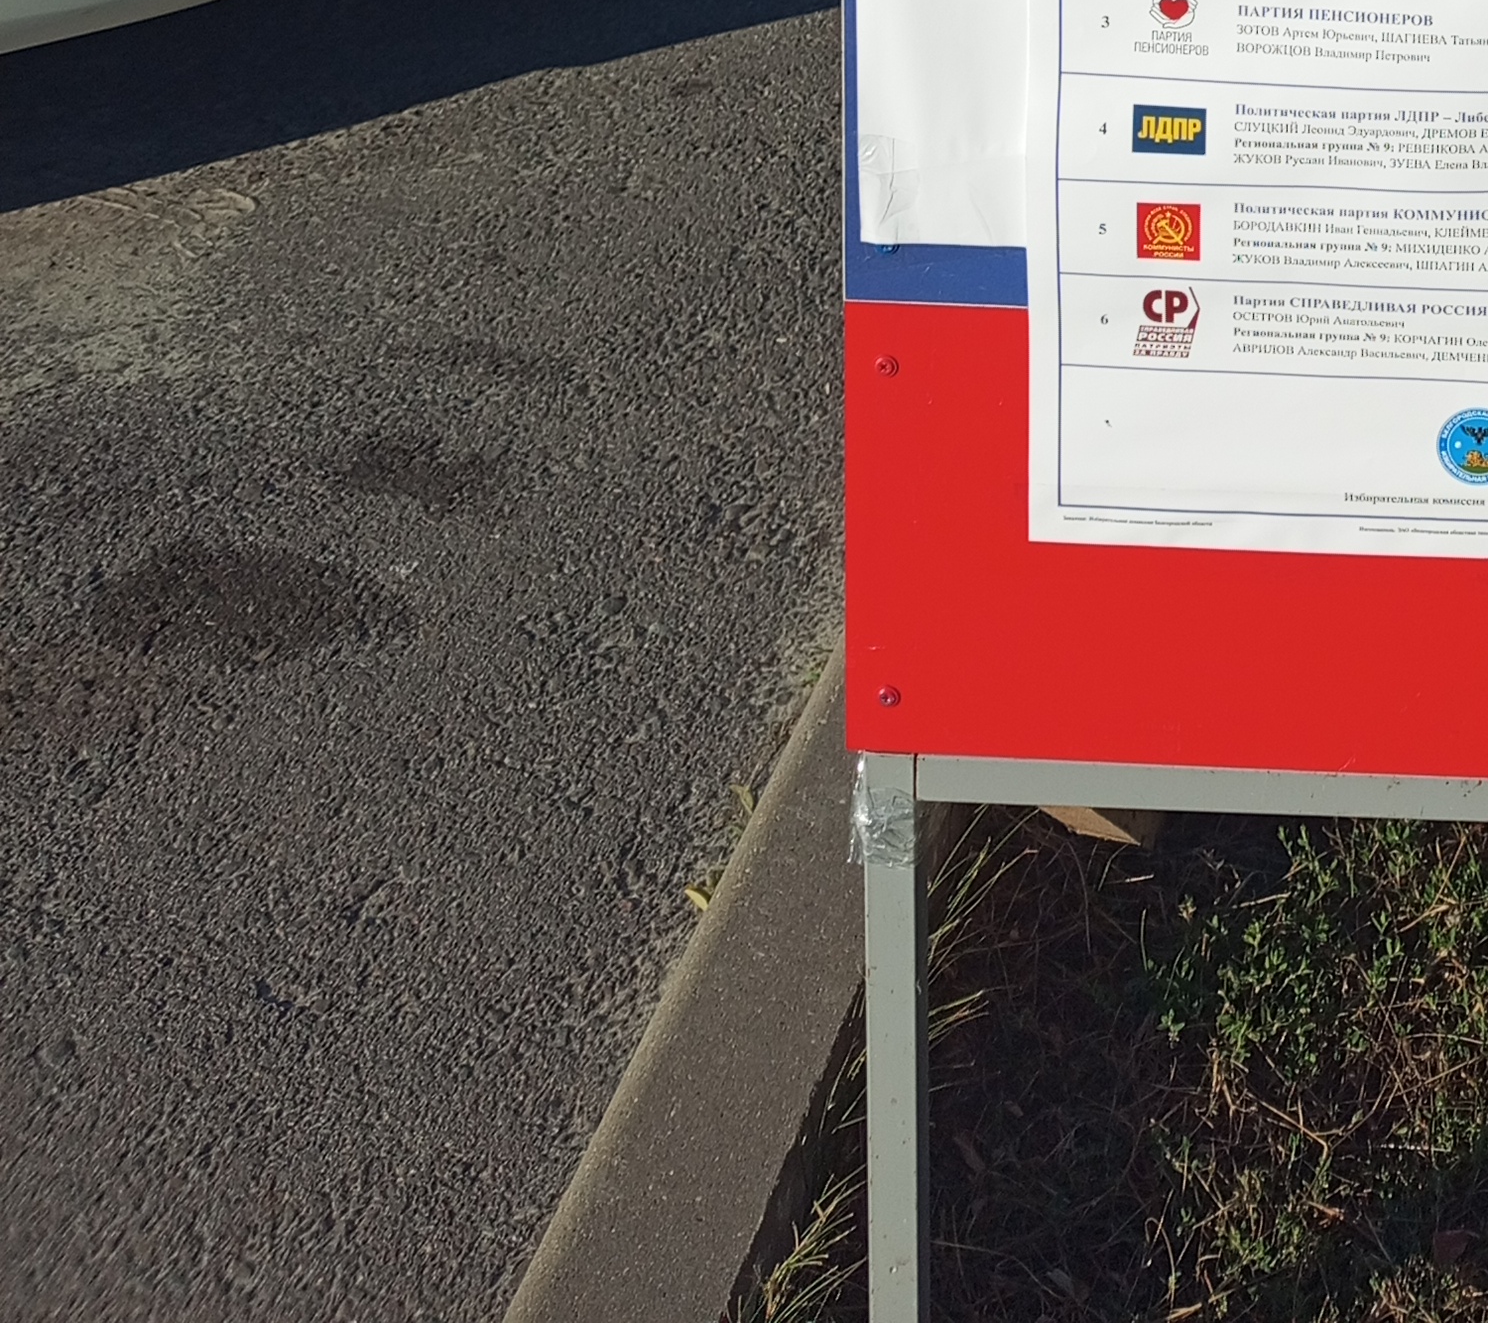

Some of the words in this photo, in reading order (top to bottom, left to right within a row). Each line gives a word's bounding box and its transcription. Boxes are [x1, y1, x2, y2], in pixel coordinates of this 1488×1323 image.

[1101, 16, 1110, 28] 3
[1239, 5, 1303, 19] ПАРТИЯ
[1309, 9, 1433, 26] ПЕНСИОНЕРОВ
[1151, 29, 1193, 42] ПАРТИЯ
[1134, 41, 1210, 57] ПЕНСИОНЕРОВ
[1236, 104, 1336, 118] Политическая
[1342, 112, 1390, 123] партия
[1394, 111, 1439, 123] ЛДПР
[1099, 122, 1107, 135] 4
[1138, 115, 1202, 144] ЛДПР
[1235, 203, 1334, 215] Политическая
[1340, 209, 1388, 220] партия
[1099, 223, 1107, 235] 5
[1143, 289, 1189, 324] СР
[1234, 296, 1285, 308] Партия
[1290, 298, 1416, 313] СПРАВЕДЛИВАЯ
[1422, 304, 1486, 316] РОССИЯ
[1101, 314, 1109, 325] 6
[1345, 493, 1429, 504] Избирательная
[1433, 498, 1485, 506] комиссия
